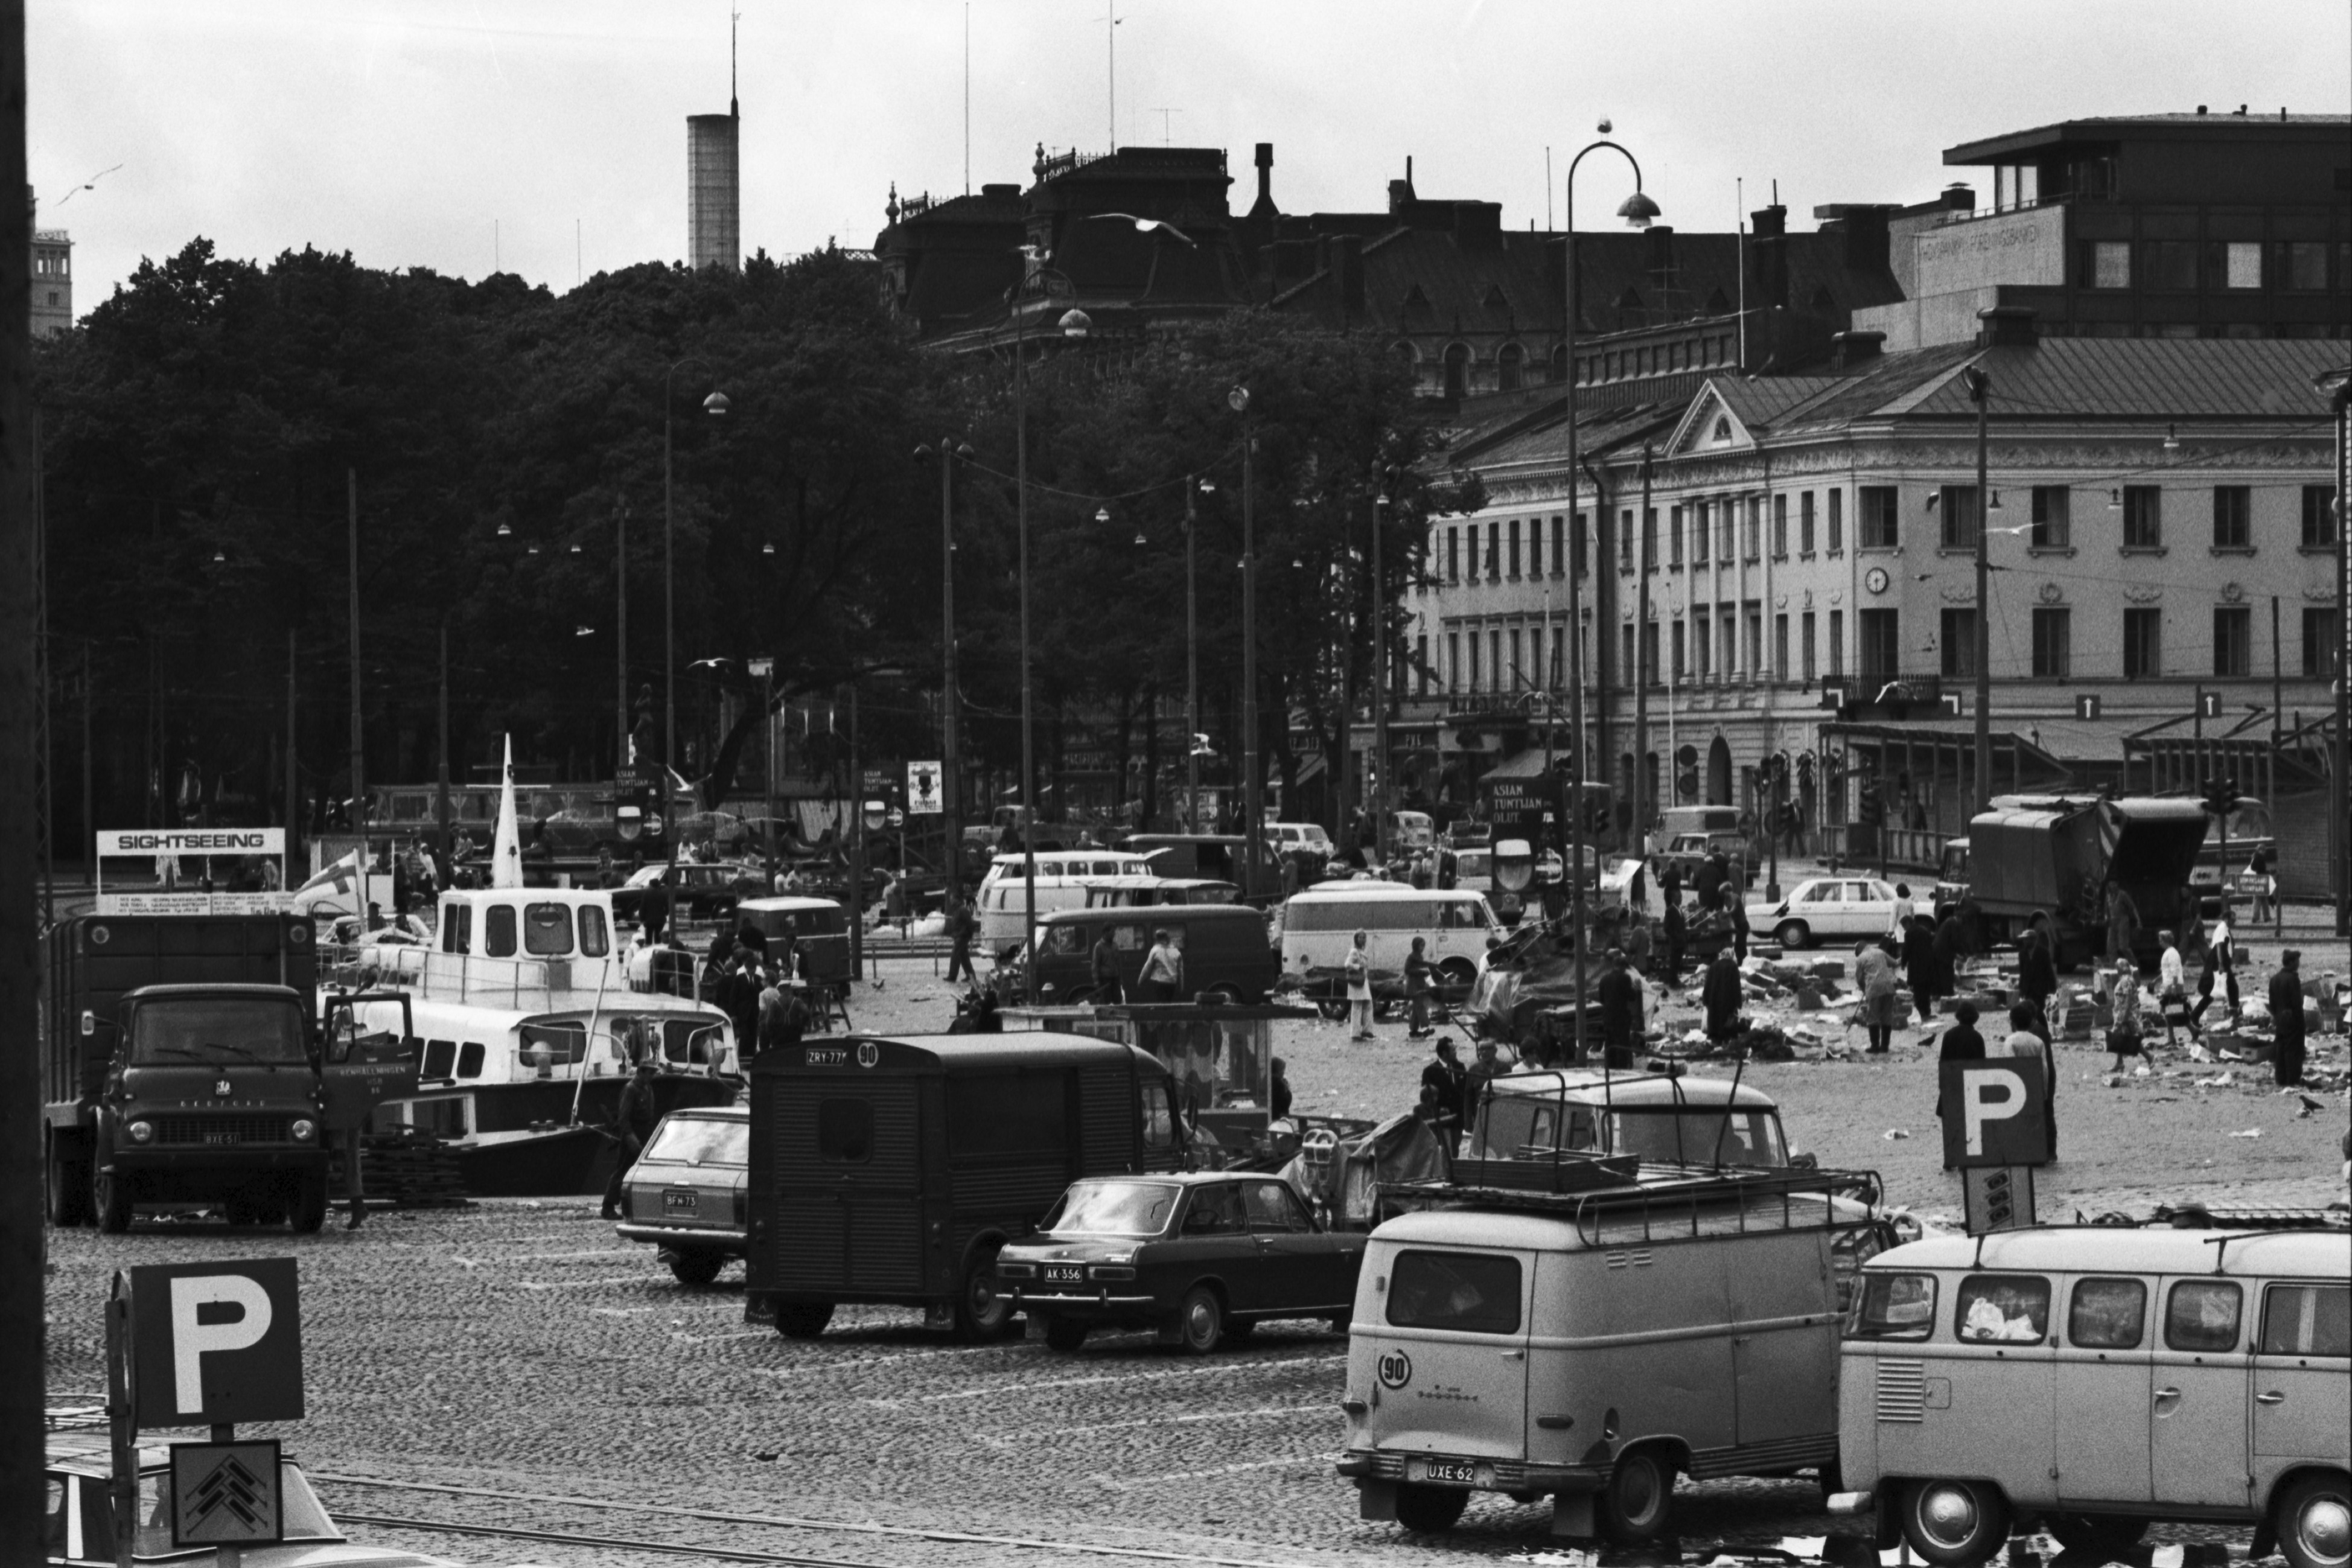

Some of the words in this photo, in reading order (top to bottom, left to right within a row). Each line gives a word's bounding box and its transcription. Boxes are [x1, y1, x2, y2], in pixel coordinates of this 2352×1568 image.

[1494, 785, 1523, 796] ASIAN
[118, 834, 264, 849] SIGHTSEEING
[860, 1045, 875, 1064] 90
[1963, 1068, 2027, 1156] P
[1047, 1269, 1080, 1279] AK-356
[171, 1274, 272, 1414] P
[1385, 1357, 1404, 1380] 90
[1429, 1465, 1473, 1480] UXE-62
